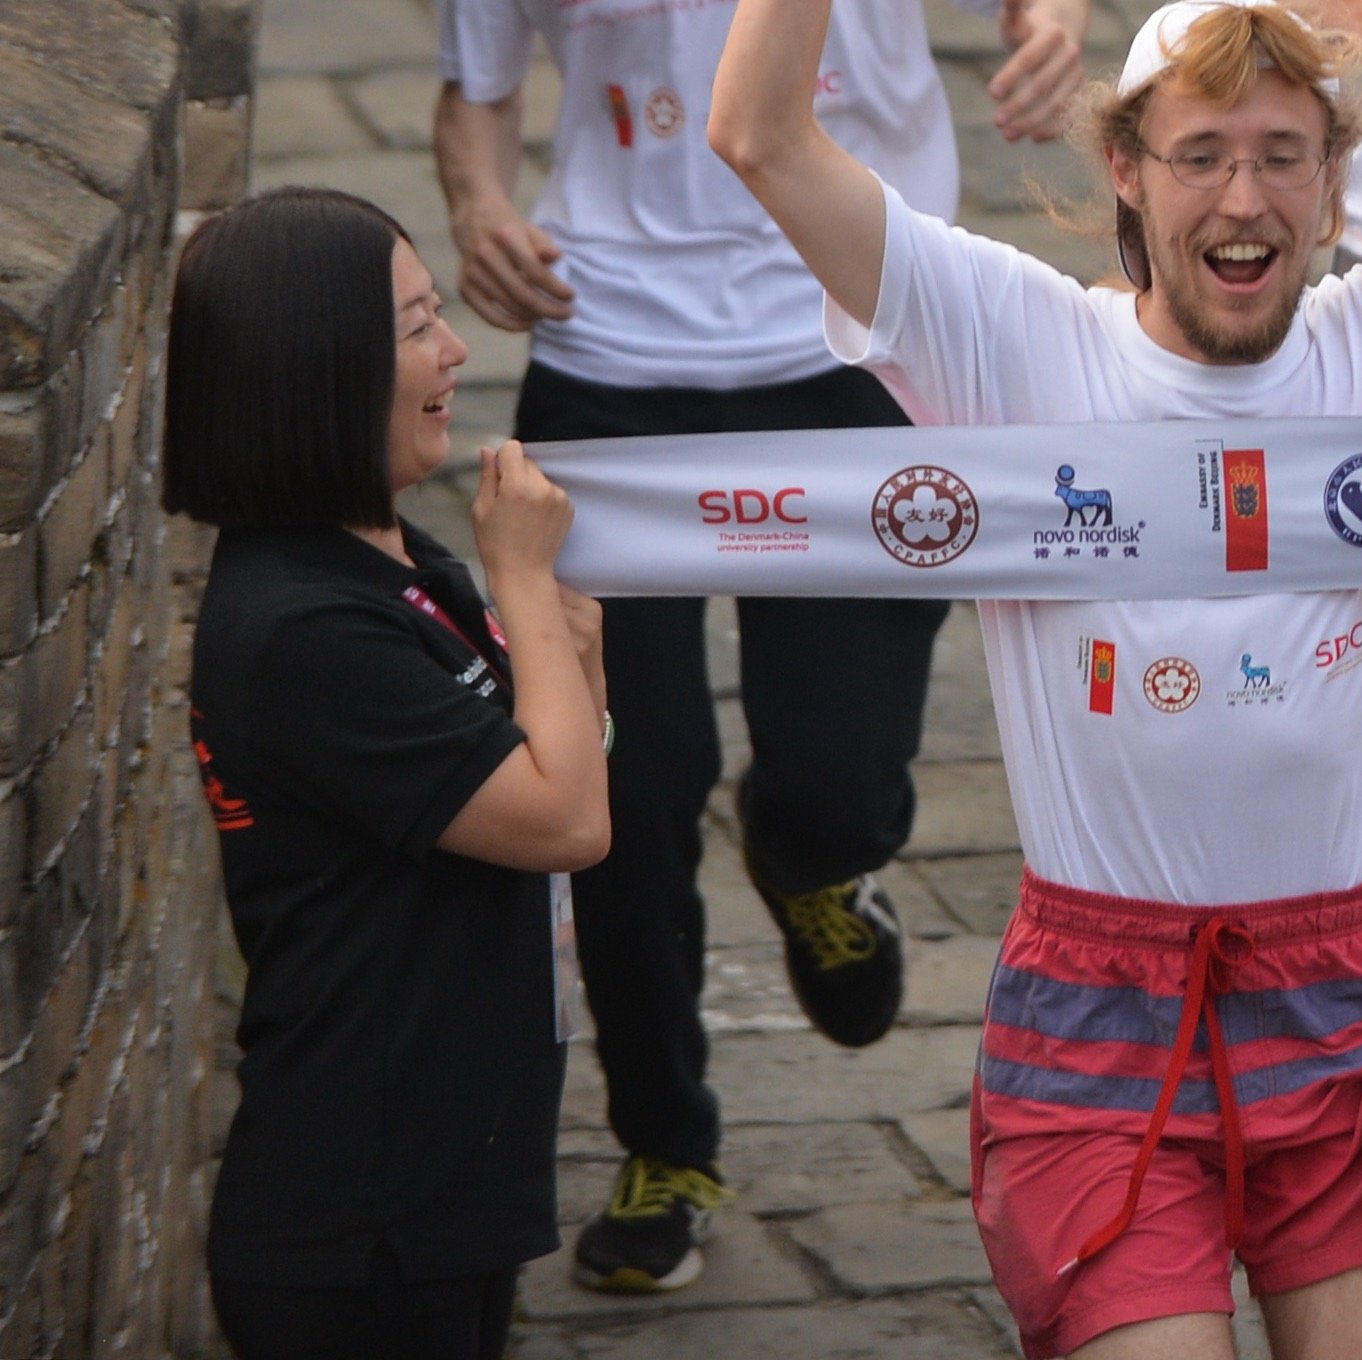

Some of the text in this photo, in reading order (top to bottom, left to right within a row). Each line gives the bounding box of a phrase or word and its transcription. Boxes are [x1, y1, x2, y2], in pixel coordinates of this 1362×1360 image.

[698, 487, 808, 525] SDC
[904, 507, 949, 524] 友好
[719, 531, 810, 542] The Denmark-China
[1033, 525, 1140, 544] novo nordisk
[717, 542, 810, 554] university partnership
[893, 541, 961, 565] CPAFFC
